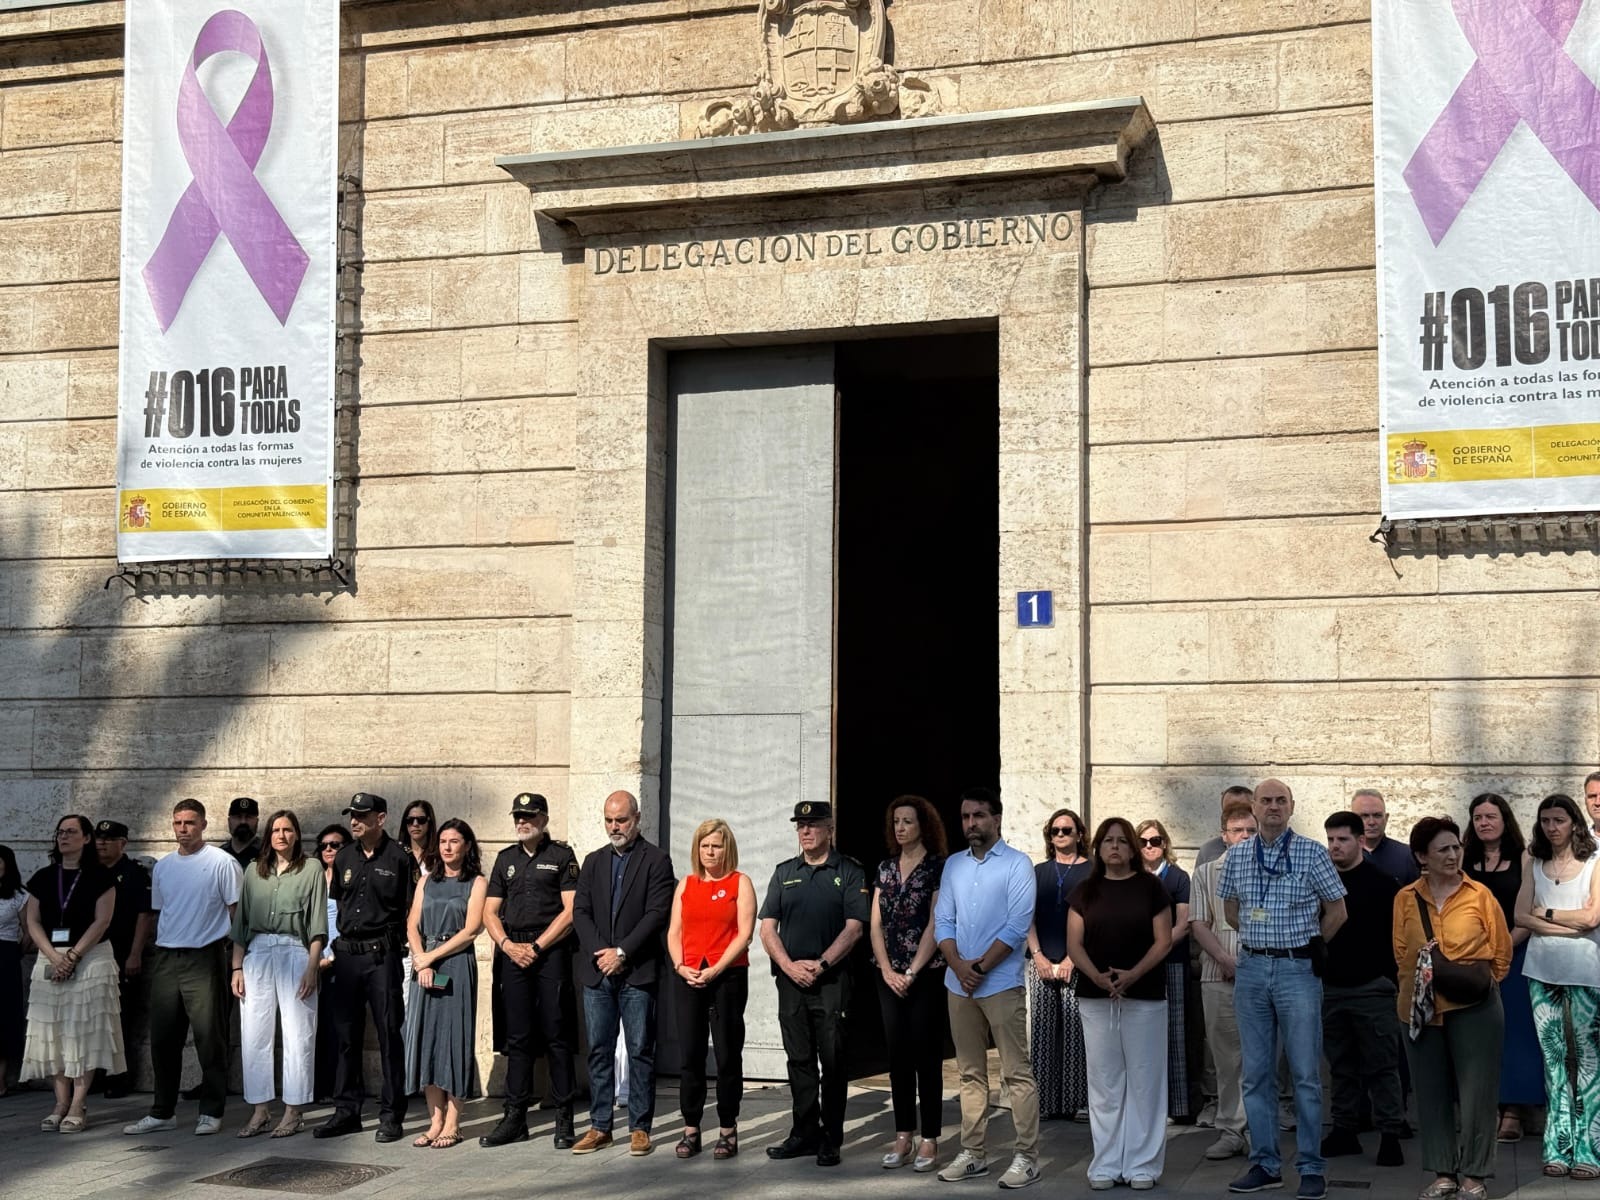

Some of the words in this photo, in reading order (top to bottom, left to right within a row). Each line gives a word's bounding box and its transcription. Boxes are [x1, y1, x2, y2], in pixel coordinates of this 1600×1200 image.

[594, 233, 817, 275] DELEGACION
[826, 232, 882, 257] DEL
[891, 212, 1073, 254] GOBIERNO
[1419, 281, 1551, 371] #016
[240, 365, 288, 400] PARA
[1429, 376, 1496, 390] Atención
[1500, 377, 1509, 387] a
[1513, 372, 1554, 385] todas
[1558, 370, 1578, 382] las
[143, 366, 236, 439] #016
[1418, 396, 1436, 407] de
[1440, 393, 1504, 406] violencia
[1509, 391, 1557, 403] contra
[1562, 387, 1582, 399] las
[240, 399, 301, 435] TODAS
[148, 443, 200, 454] Atención
[202, 446, 208, 454] a
[211, 443, 237, 453] todas
[239, 442, 254, 451] las
[257, 441, 294, 451] formas
[1452, 444, 1512, 455] GOBIERNO
[140, 459, 153, 469] de
[155, 458, 204, 468] violencia
[207, 459, 239, 468] contra
[241, 456, 256, 466] las
[259, 455, 303, 468] mujeres
[1453, 456, 1468, 465] DE
[1470, 453, 1513, 464] ESPAÑA
[162, 502, 207, 510] GOBIERNO
[162, 510, 173, 518] DE
[1027, 594, 1039, 623] 1
